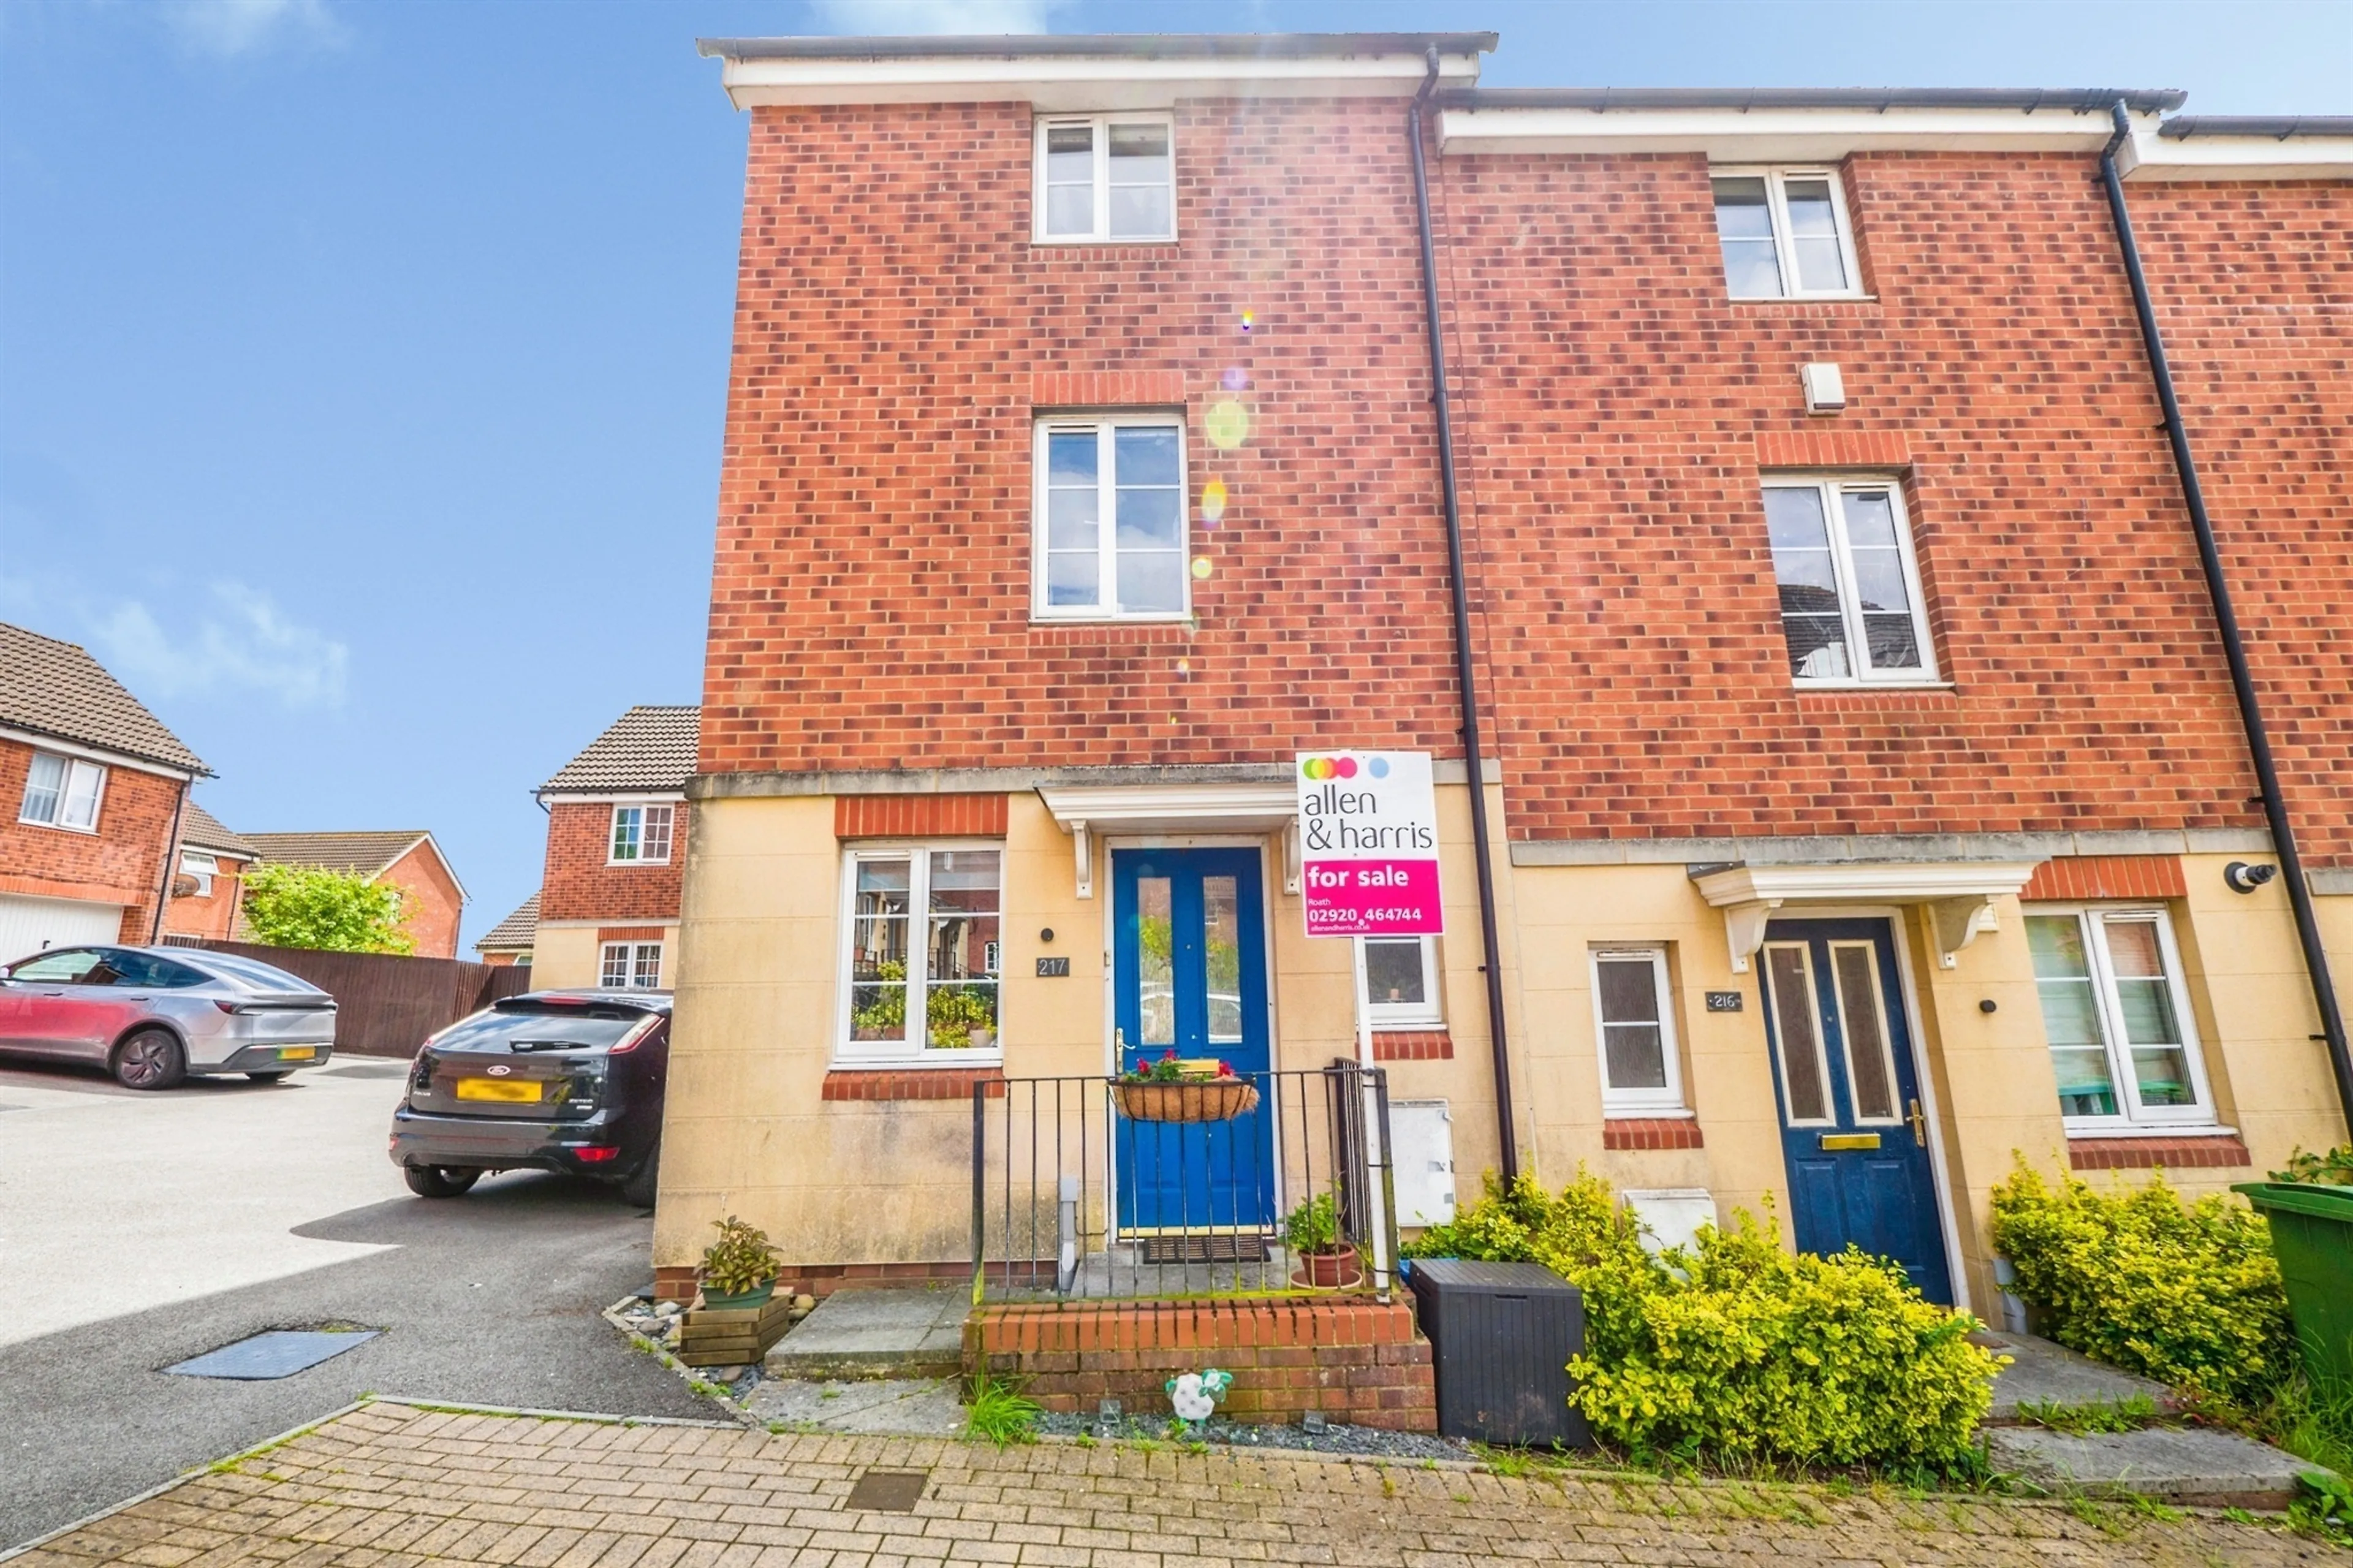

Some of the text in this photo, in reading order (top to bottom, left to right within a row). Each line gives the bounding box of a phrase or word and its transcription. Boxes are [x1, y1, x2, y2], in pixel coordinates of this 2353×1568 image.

[1305, 784, 1376, 816] allen
[1306, 819, 1432, 850] & harris
[1308, 865, 1409, 887] for sale
[1309, 908, 1422, 922] 02920 464744
[1039, 959, 1066, 975] 217
[1715, 995, 1735, 1007] 216
